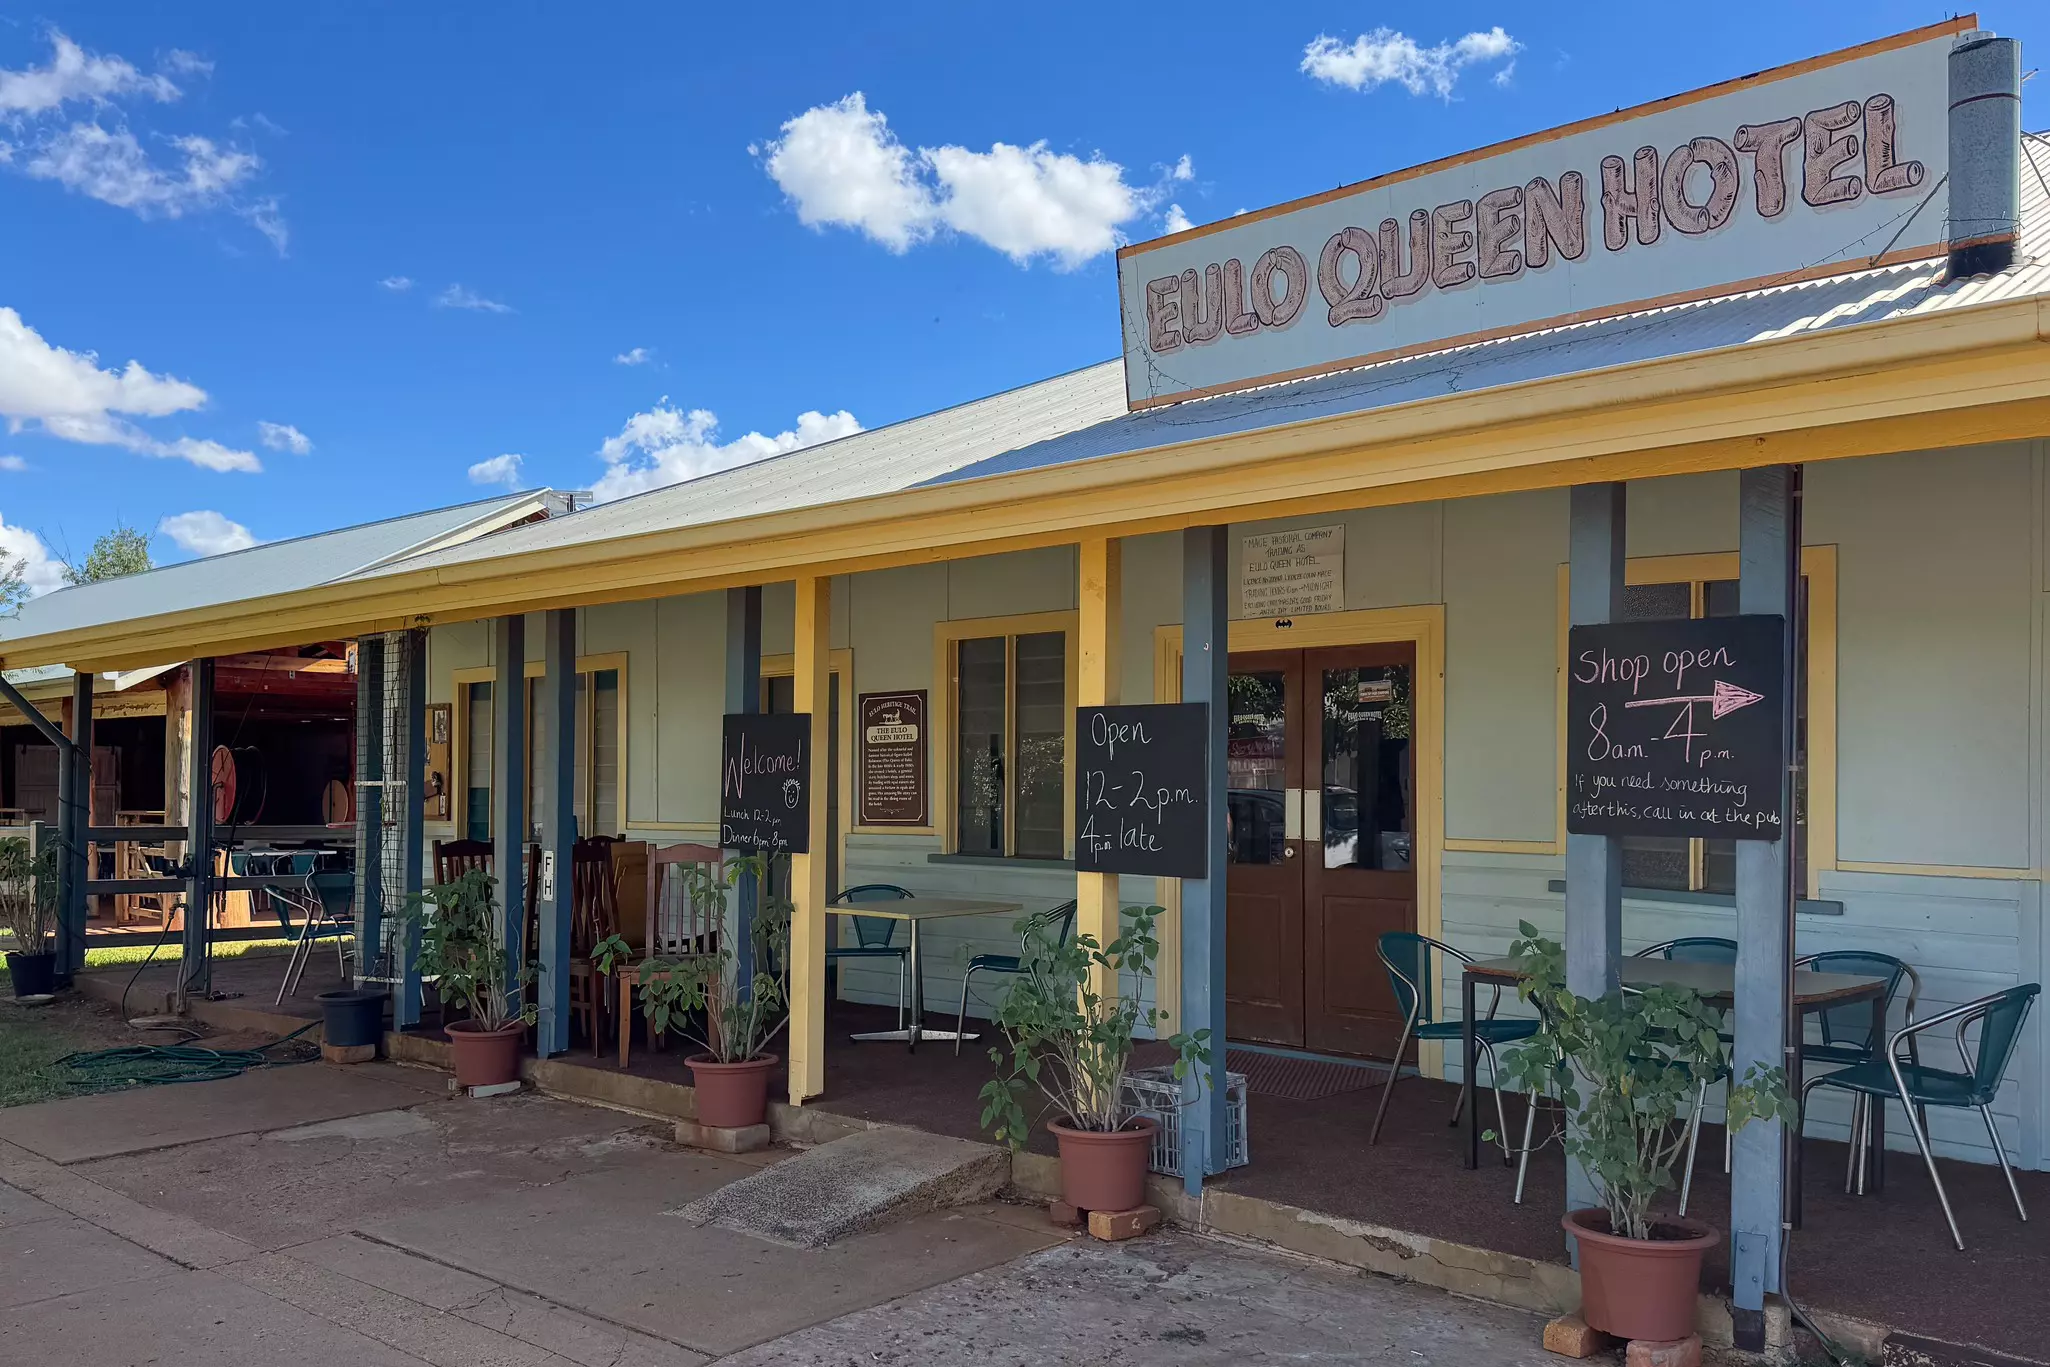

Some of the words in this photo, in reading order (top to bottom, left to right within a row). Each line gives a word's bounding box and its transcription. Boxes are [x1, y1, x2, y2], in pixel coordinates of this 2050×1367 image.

[1146, 245, 1308, 354] EULO
[1319, 171, 1585, 328] QUEEN
[1601, 93, 1925, 252] HOTEL
[1305, 530, 1332, 541] COMPANY
[1266, 546, 1292, 557] TRADING
[1296, 544, 1305, 553] AS
[1249, 563, 1268, 572] EULO
[1270, 559, 1291, 571] QUEEN
[1296, 555, 1320, 567] HOTEL
[1574, 648, 1649, 695] Shop
[1663, 647, 1736, 690] open
[869, 705, 880, 717] EULO
[903, 702, 916, 715] TRAIL
[870, 734, 892, 742] QUEEN
[890, 726, 907, 734] EULO
[1091, 713, 1152, 760] Open
[725, 732, 801, 799] Welcome!
[1575, 774, 1584, 792] If
[1591, 775, 1616, 798] you
[1621, 772, 1654, 789] need
[1660, 778, 1747, 807] something
[724, 805, 749, 820] Lunch
[1573, 803, 1605, 819] after
[1643, 805, 1672, 820] call
[1679, 805, 1696, 820] in
[1700, 808, 1721, 824] at
[1726, 808, 1752, 825] the
[1756, 810, 1780, 829] pub
[723, 824, 752, 844] Dinner
